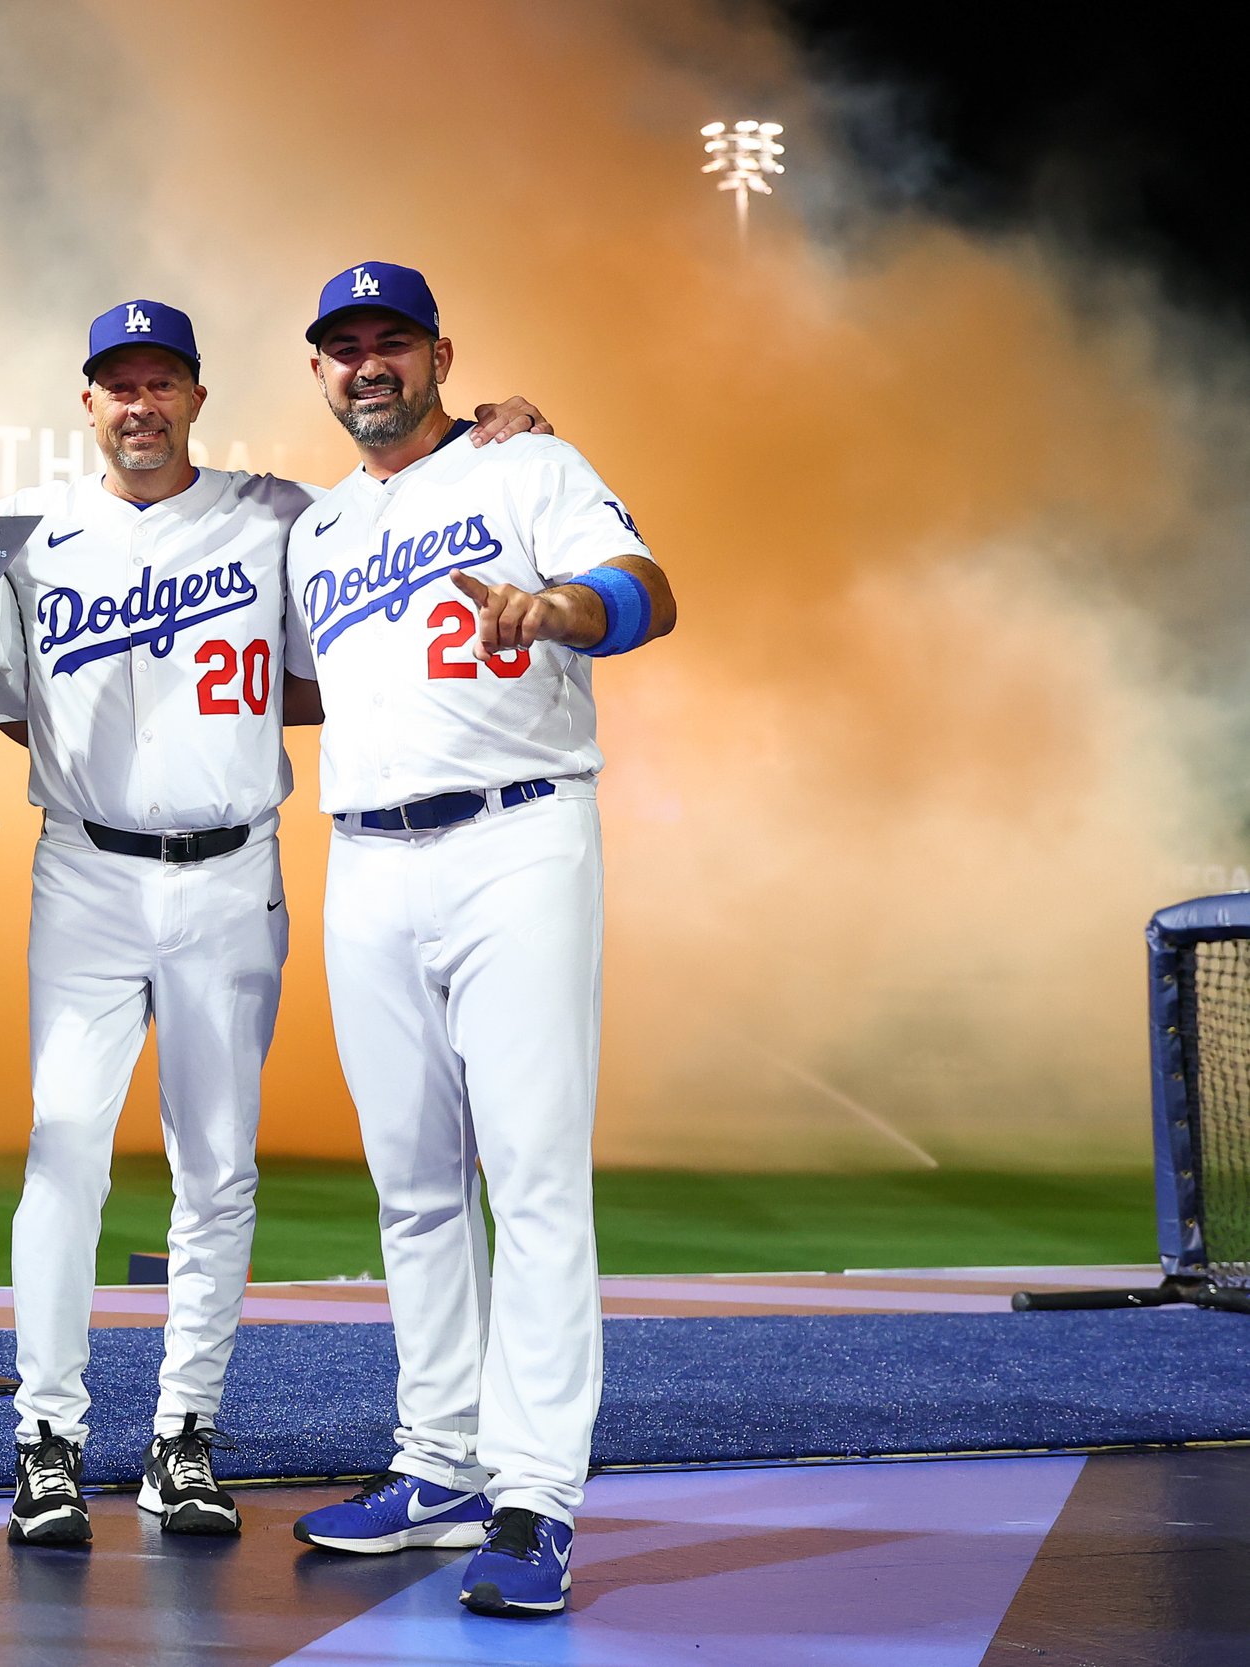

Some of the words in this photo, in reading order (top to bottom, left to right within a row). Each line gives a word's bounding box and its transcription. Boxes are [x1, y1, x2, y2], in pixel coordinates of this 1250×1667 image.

[125, 303, 151, 333] LA
[351, 266, 380, 298] LA
[37, 560, 258, 679] Dodgers
[303, 514, 503, 657] Dodgers
[194, 638, 271, 716] 20
